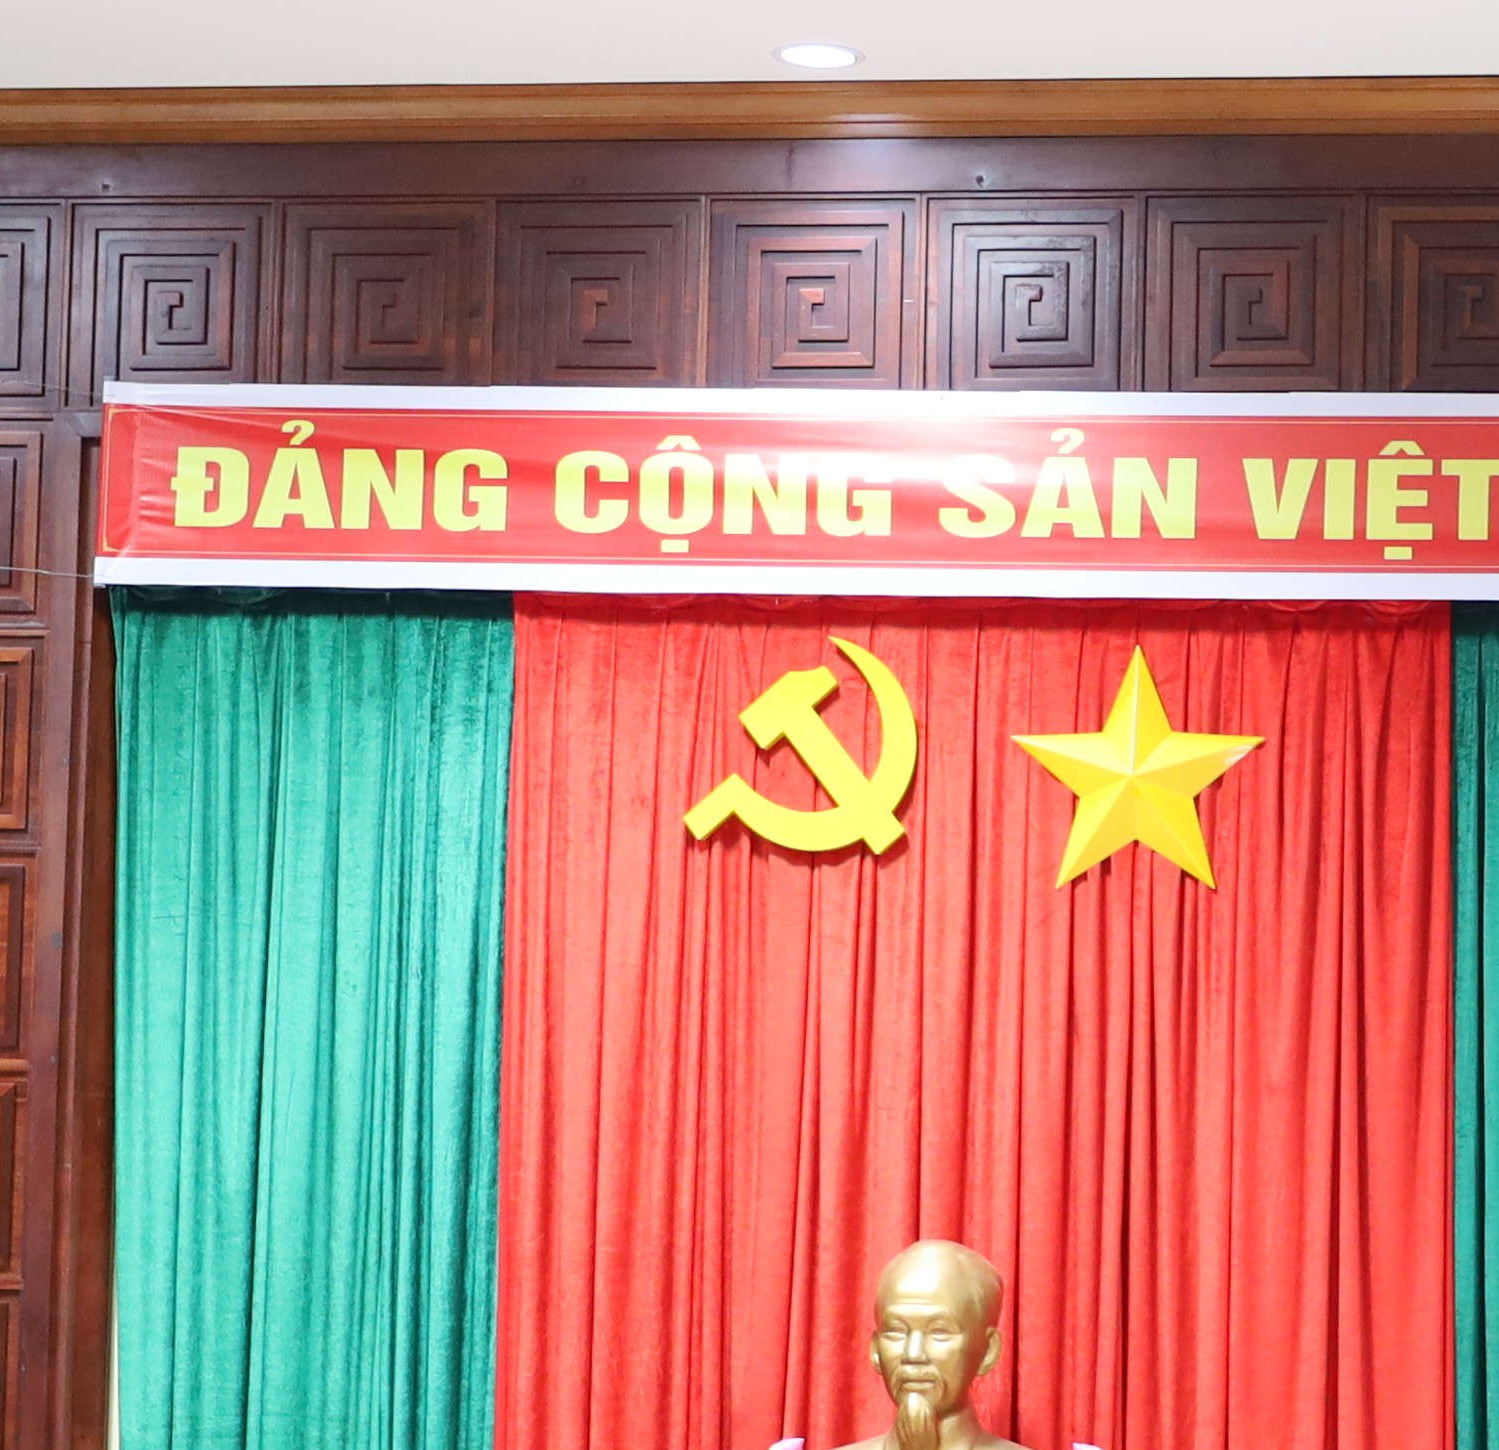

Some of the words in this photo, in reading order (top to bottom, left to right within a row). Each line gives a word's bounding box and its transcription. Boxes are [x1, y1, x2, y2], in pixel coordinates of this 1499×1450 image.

[171, 418, 509, 532] ĐẢNG
[554, 434, 895, 554] CỘNG
[938, 427, 1198, 542] SẢN
